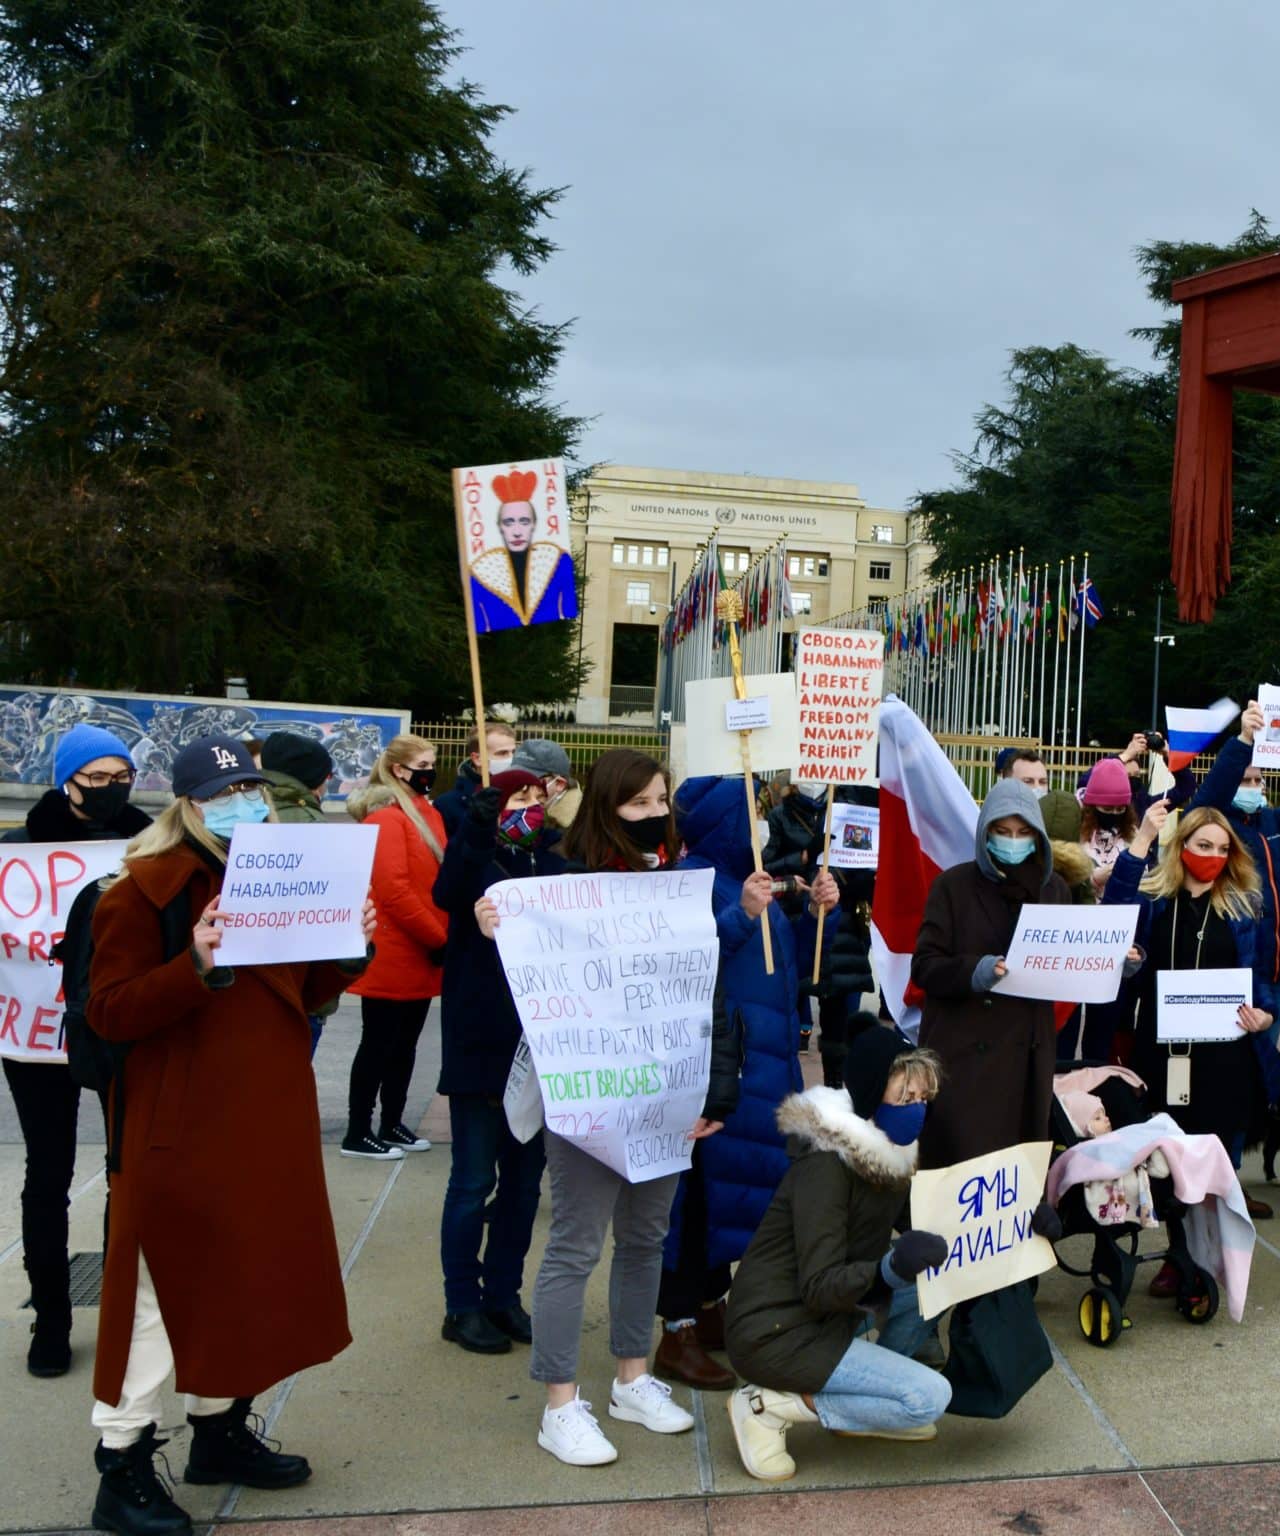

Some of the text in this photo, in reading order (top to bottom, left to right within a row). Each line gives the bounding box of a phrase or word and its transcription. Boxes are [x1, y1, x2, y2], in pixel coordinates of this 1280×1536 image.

[543, 462, 560, 536] ЦАРЯ
[631, 504, 710, 517] UNITED NATIONS
[462, 471, 484, 553] ДОЛОЙ
[741, 512, 817, 526] NATIONS UNIES
[802, 633, 879, 651] СВОБОДУ
[801, 672, 871, 692] LIBERTÉ
[812, 693, 880, 708] NAVALNY
[800, 710, 869, 724] FREEDOM
[804, 727, 875, 742] NAVALNY
[211, 746, 240, 769] LA
[798, 763, 867, 781] NAVALNY
[235, 853, 303, 872] СВОБОДУ
[0, 850, 87, 919] OP
[229, 880, 329, 898] НАВАЛЬНОМУ
[609, 871, 697, 905] PEOPLE
[223, 908, 351, 931] СВОБОДУ РОССИИ
[537, 910, 675, 952] IN RUSSIA
[1022, 929, 1129, 945] FREE NAVALNY
[584, 959, 612, 992] ON
[620, 952, 658, 978] LESS
[666, 950, 713, 974] THEN
[1024, 956, 1115, 971] FREE RUSSIA
[623, 985, 656, 1012] PER
[660, 975, 715, 1007] MONTH
[529, 1028, 597, 1056] WHILE
[600, 1025, 654, 1056] PUTIN
[663, 1018, 692, 1050] BUYS
[540, 1070, 592, 1101] TOILET
[596, 1063, 662, 1099] BRUSHES
[664, 1055, 701, 1091] WORTH
[617, 1107, 635, 1136] IN
[640, 1100, 669, 1131] HIS
[628, 1129, 694, 1170] RESIDENCE
